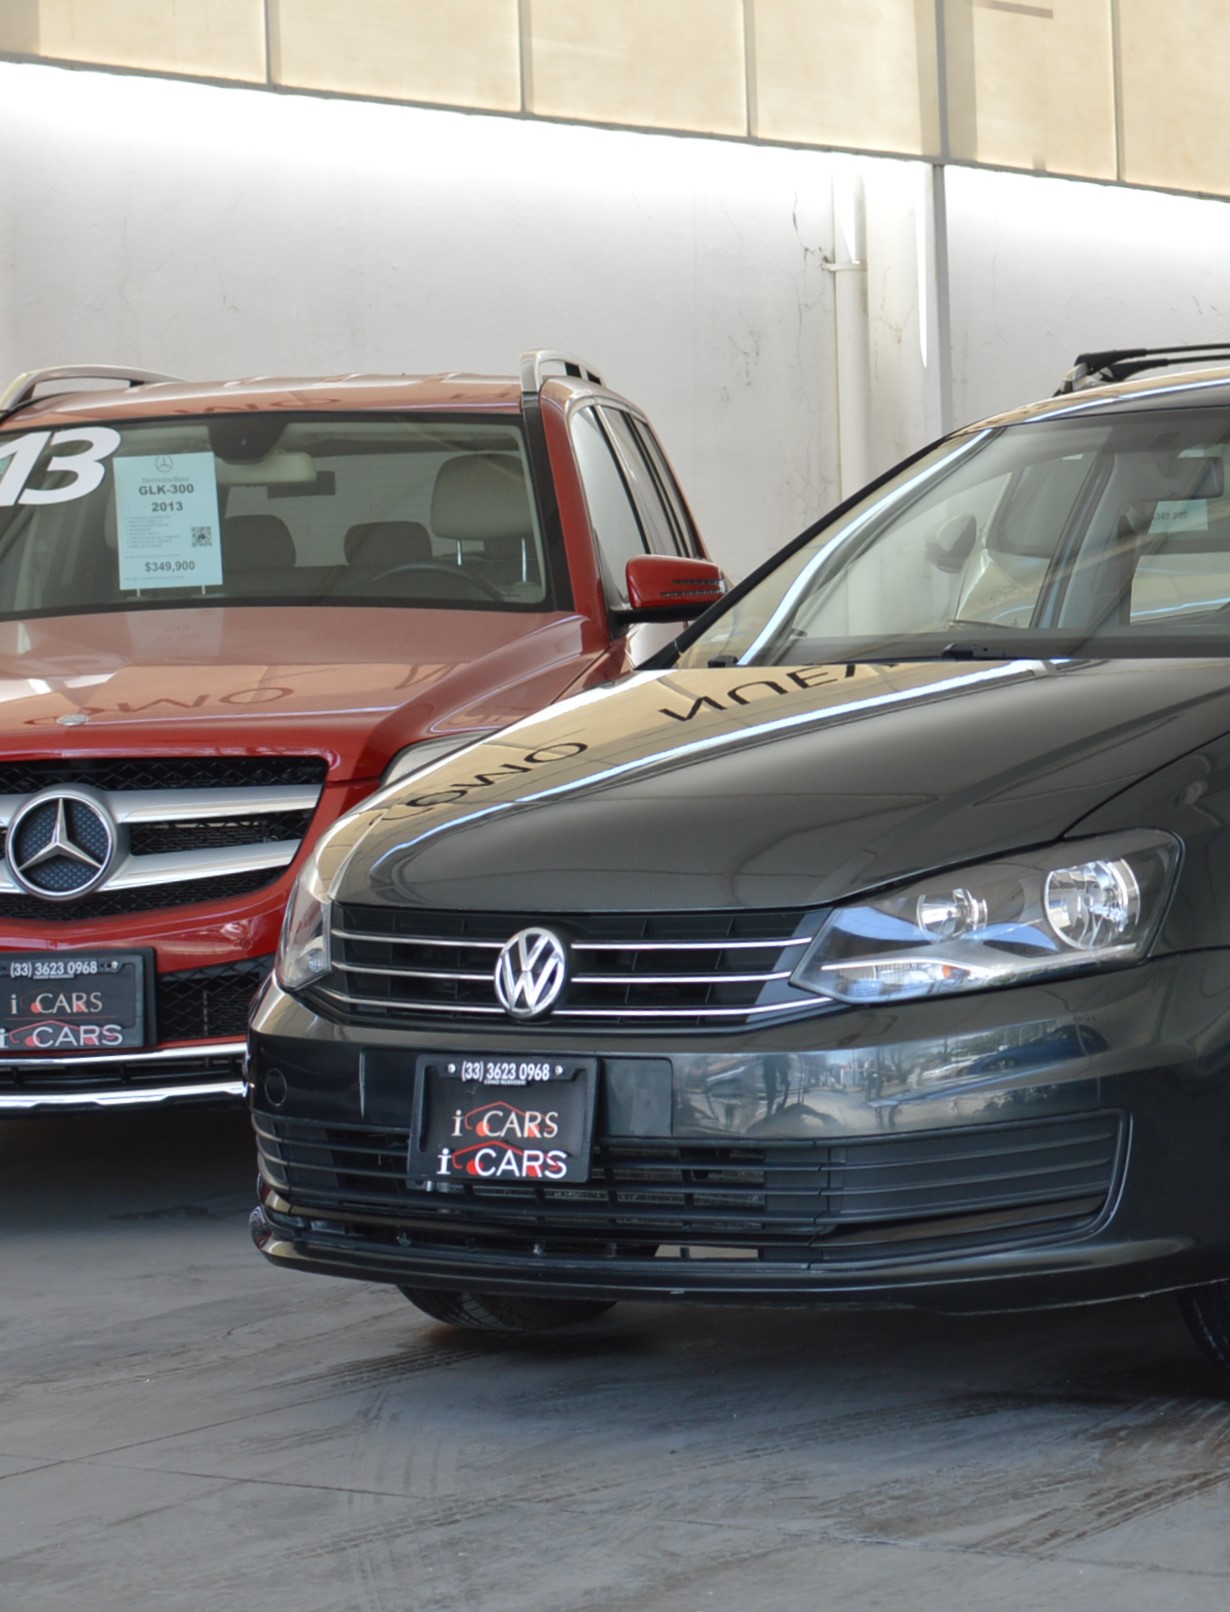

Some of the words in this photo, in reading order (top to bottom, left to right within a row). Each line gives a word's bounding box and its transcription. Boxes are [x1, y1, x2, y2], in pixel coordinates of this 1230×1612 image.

[138, 483, 194, 496] GLK-300
[151, 501, 183, 512] 2013
[144, 560, 195, 573] $349,900
[10, 961, 32, 978] (33)
[34, 961, 64, 976] 3623
[67, 960, 98, 974] 0968
[35, 991, 103, 1014] CARS
[32, 1024, 123, 1047] CARS
[461, 1060, 484, 1082] (33)
[486, 1062, 517, 1080] 3623
[519, 1063, 550, 1081] 0968
[452, 1110, 464, 1136] i
[482, 1110, 558, 1138] CARS
[437, 1148, 452, 1175] i
[475, 1148, 567, 1179] CARS
